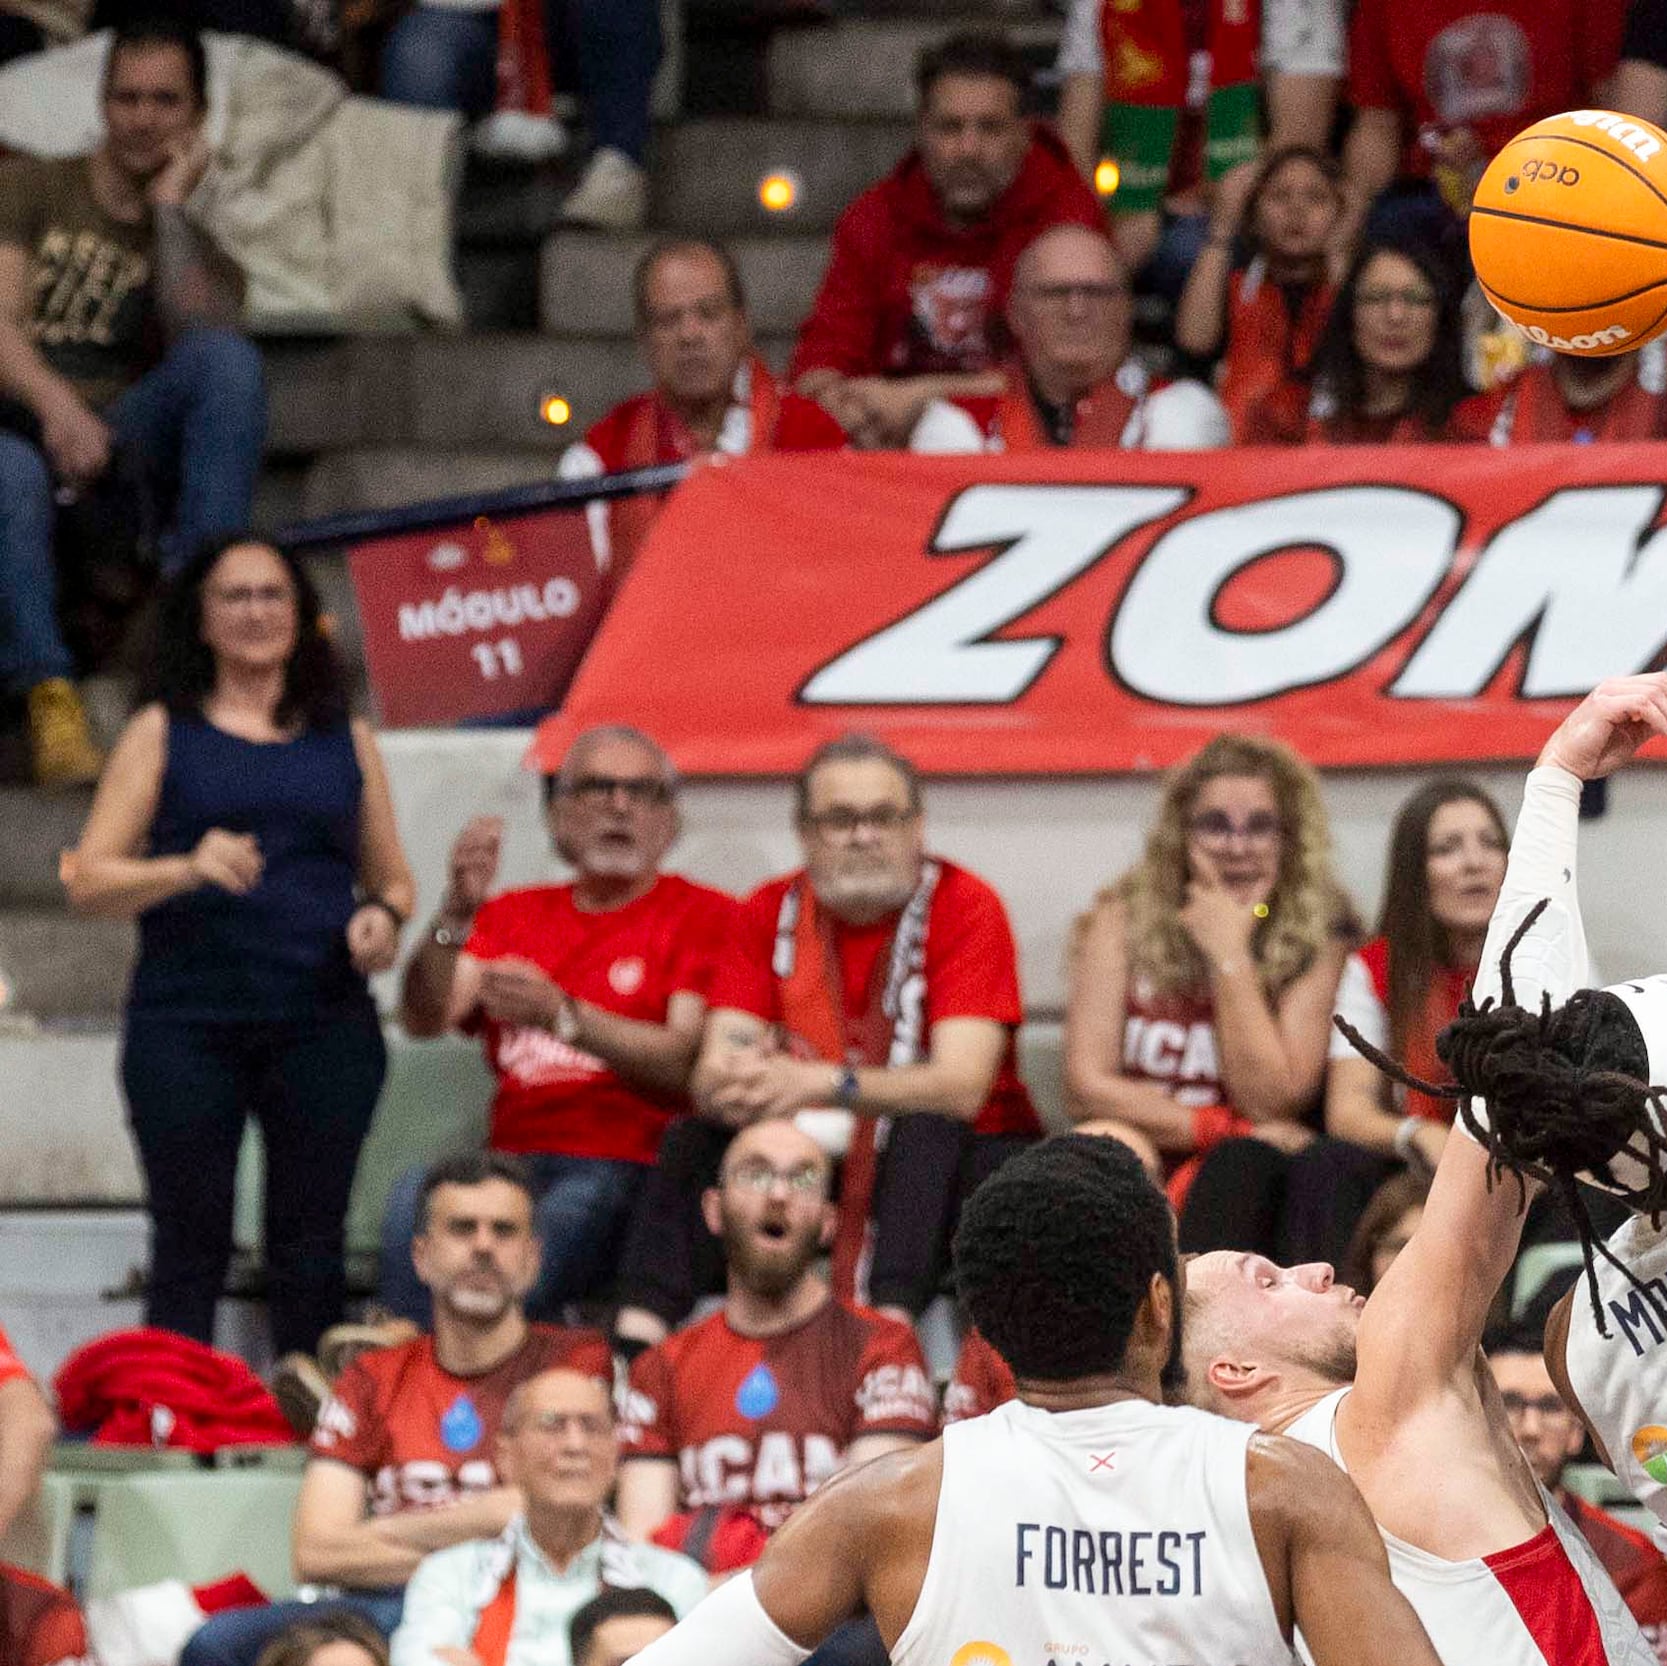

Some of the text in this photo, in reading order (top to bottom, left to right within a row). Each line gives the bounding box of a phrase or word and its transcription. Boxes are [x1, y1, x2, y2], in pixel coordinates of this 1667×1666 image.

[398, 577, 581, 641] MÓDULO
[471, 638, 525, 679] 11
[1016, 1523, 1207, 1597] FORREST
